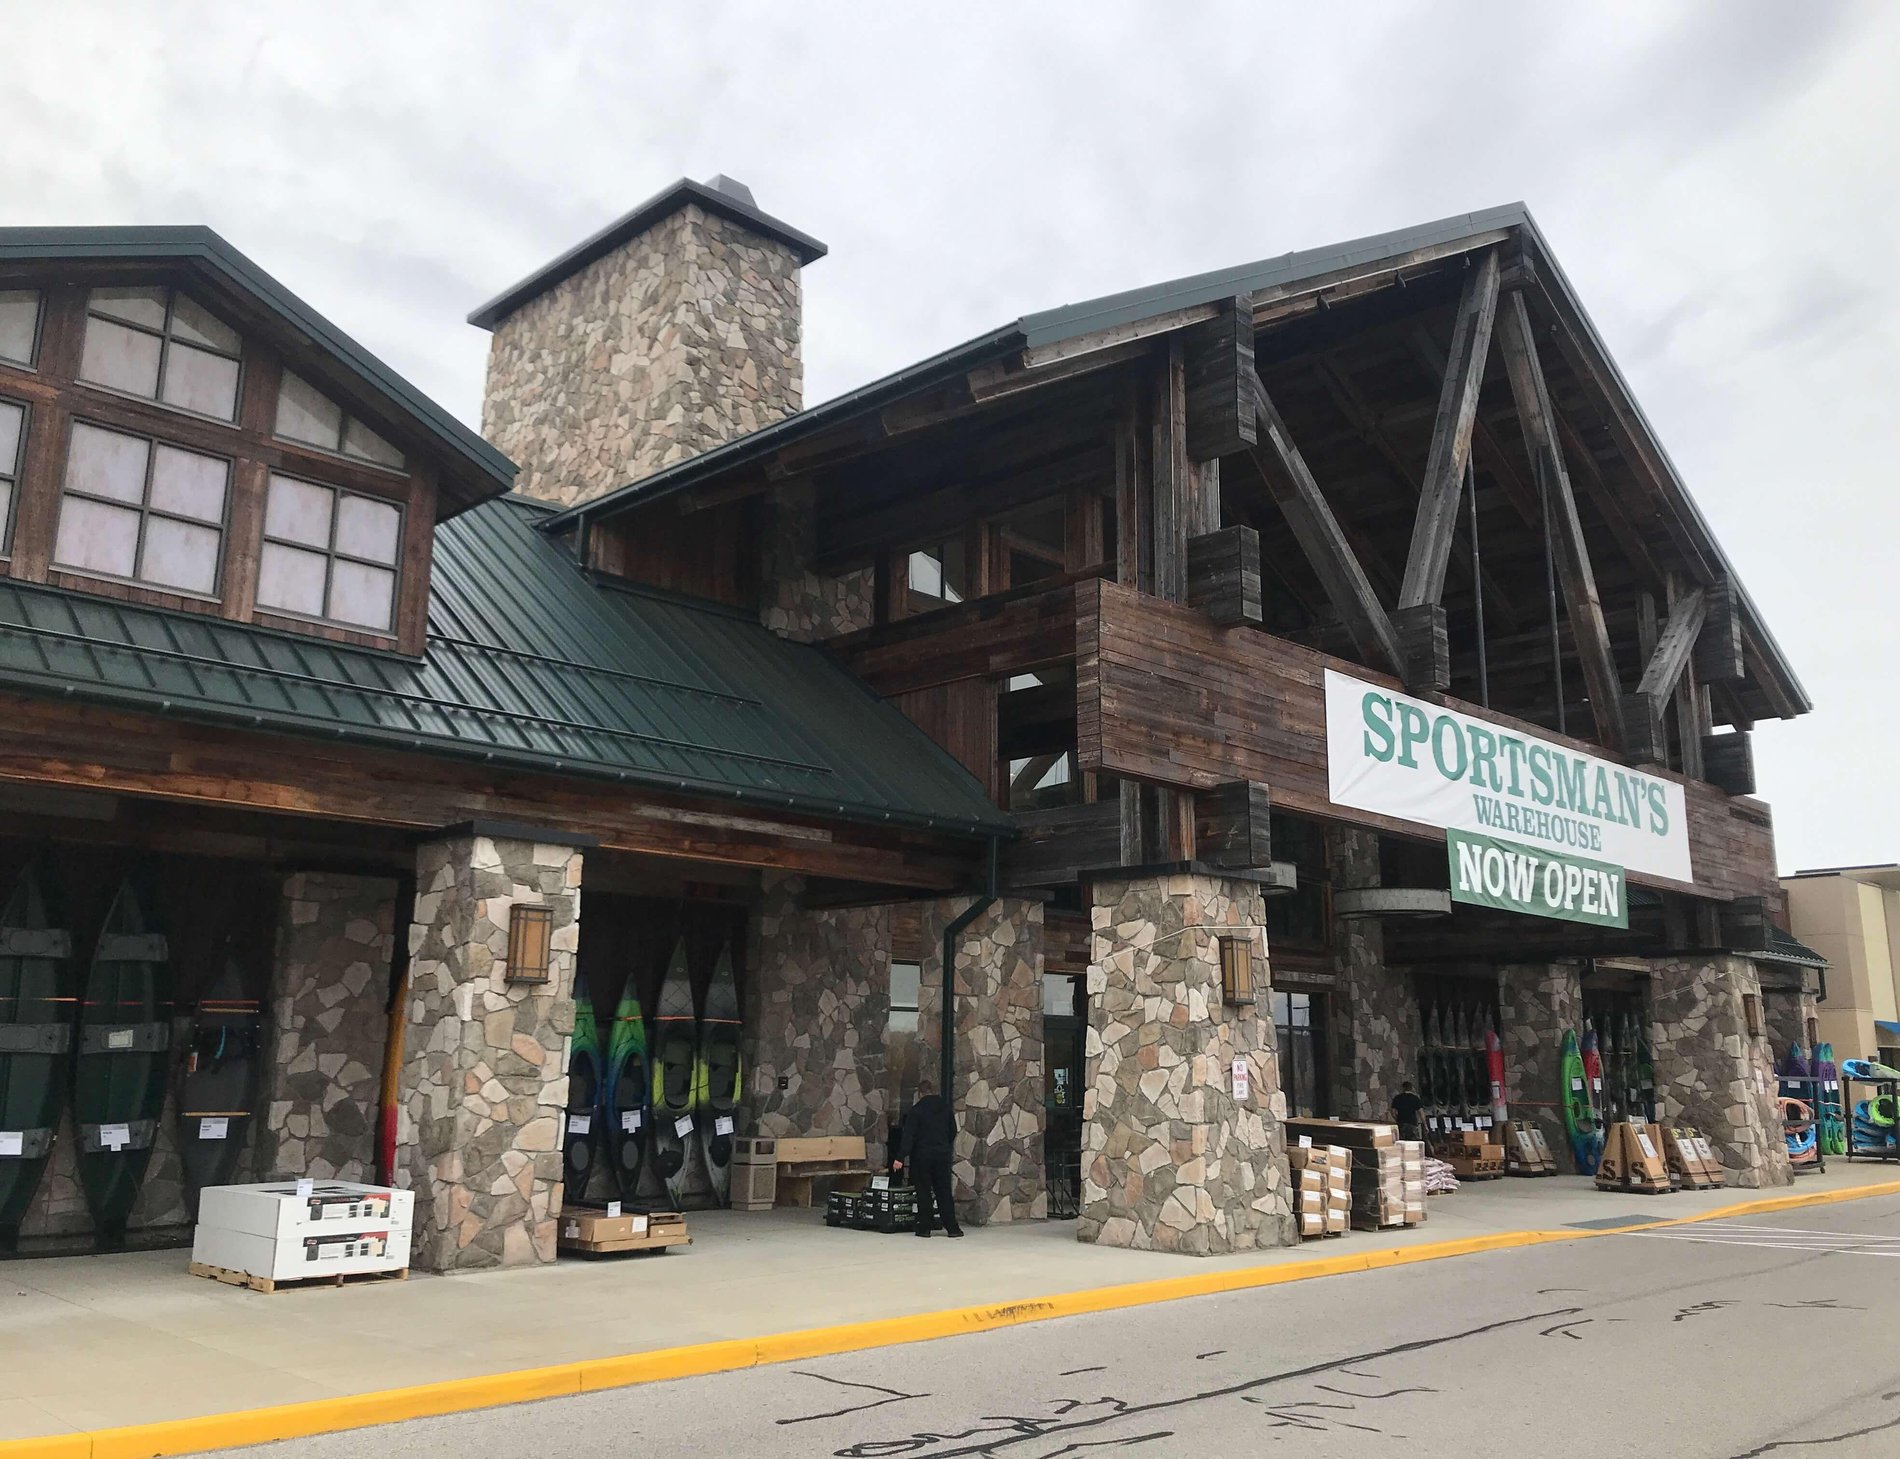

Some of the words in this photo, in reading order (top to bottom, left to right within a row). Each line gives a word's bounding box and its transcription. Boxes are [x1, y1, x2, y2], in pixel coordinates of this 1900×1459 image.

[1361, 691, 1669, 837] SPORTSMAN'S
[1472, 794, 1602, 852] WAREHOUSE
[1456, 841, 1539, 904] NOW
[1543, 860, 1620, 918] OPEN
